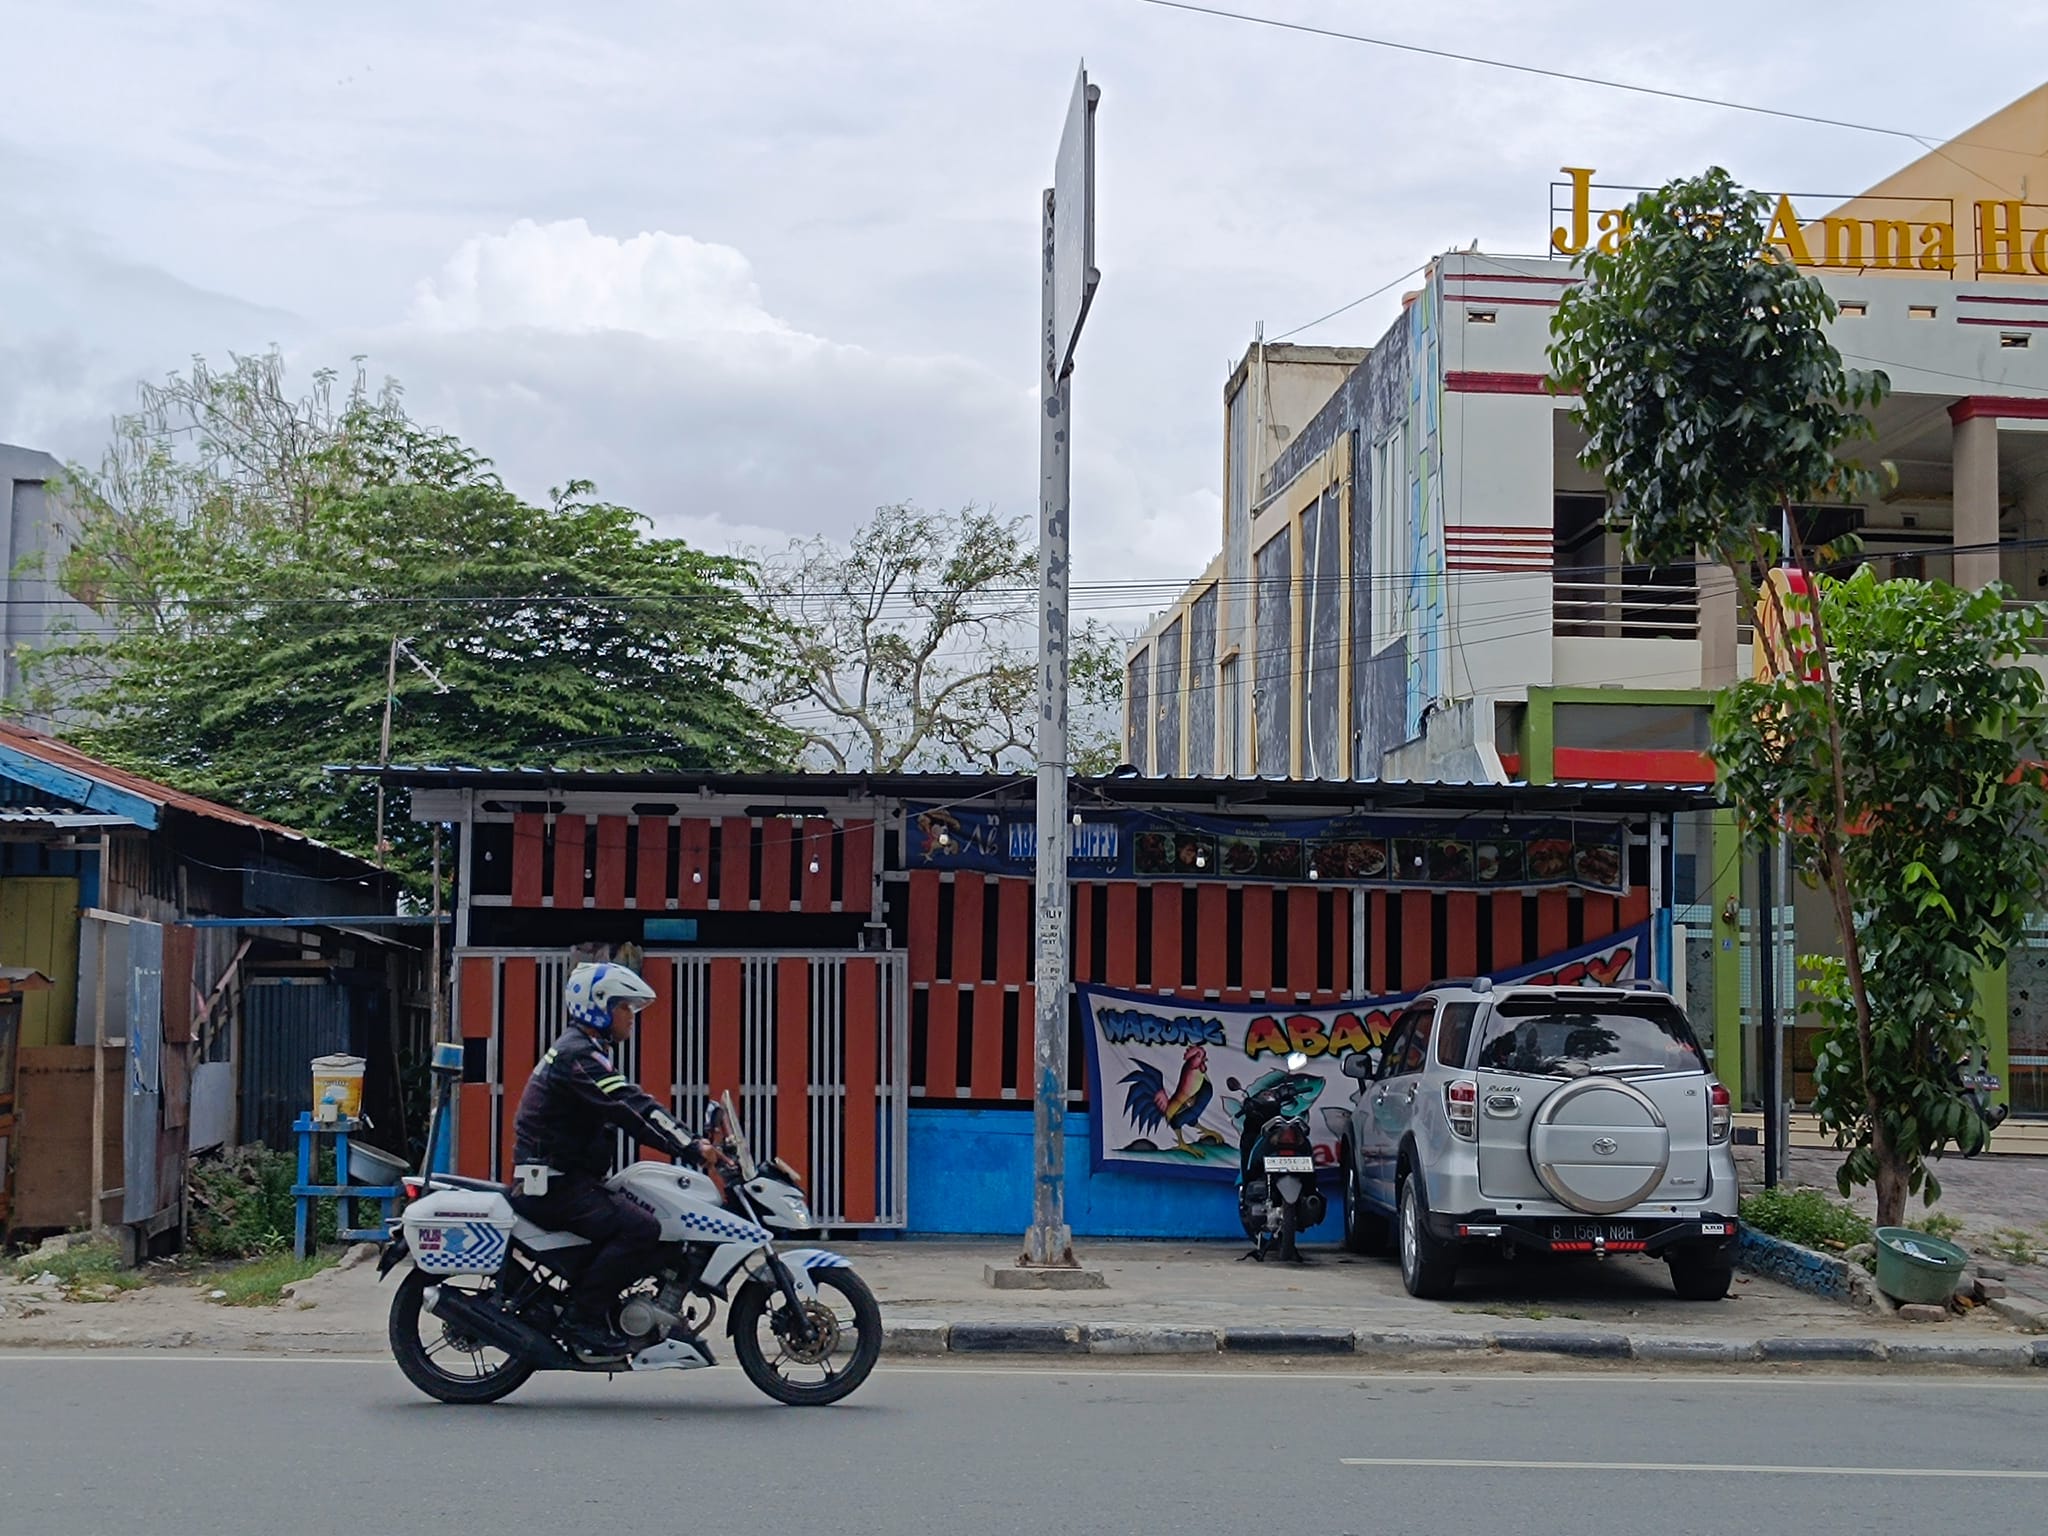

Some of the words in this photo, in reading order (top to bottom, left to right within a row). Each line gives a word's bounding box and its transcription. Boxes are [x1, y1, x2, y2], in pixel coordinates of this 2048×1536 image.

[1760, 193, 1957, 271] Anna
[1071, 825, 1118, 857] LUFFY
[1096, 1007, 1227, 1047] WARUNG
[1245, 1008, 1403, 1058] ABAN
[618, 1185, 657, 1215] POLISI
[418, 1228, 442, 1243] POLISI
[1552, 1225, 1562, 1240] B
[1573, 1225, 1602, 1240] 1560
